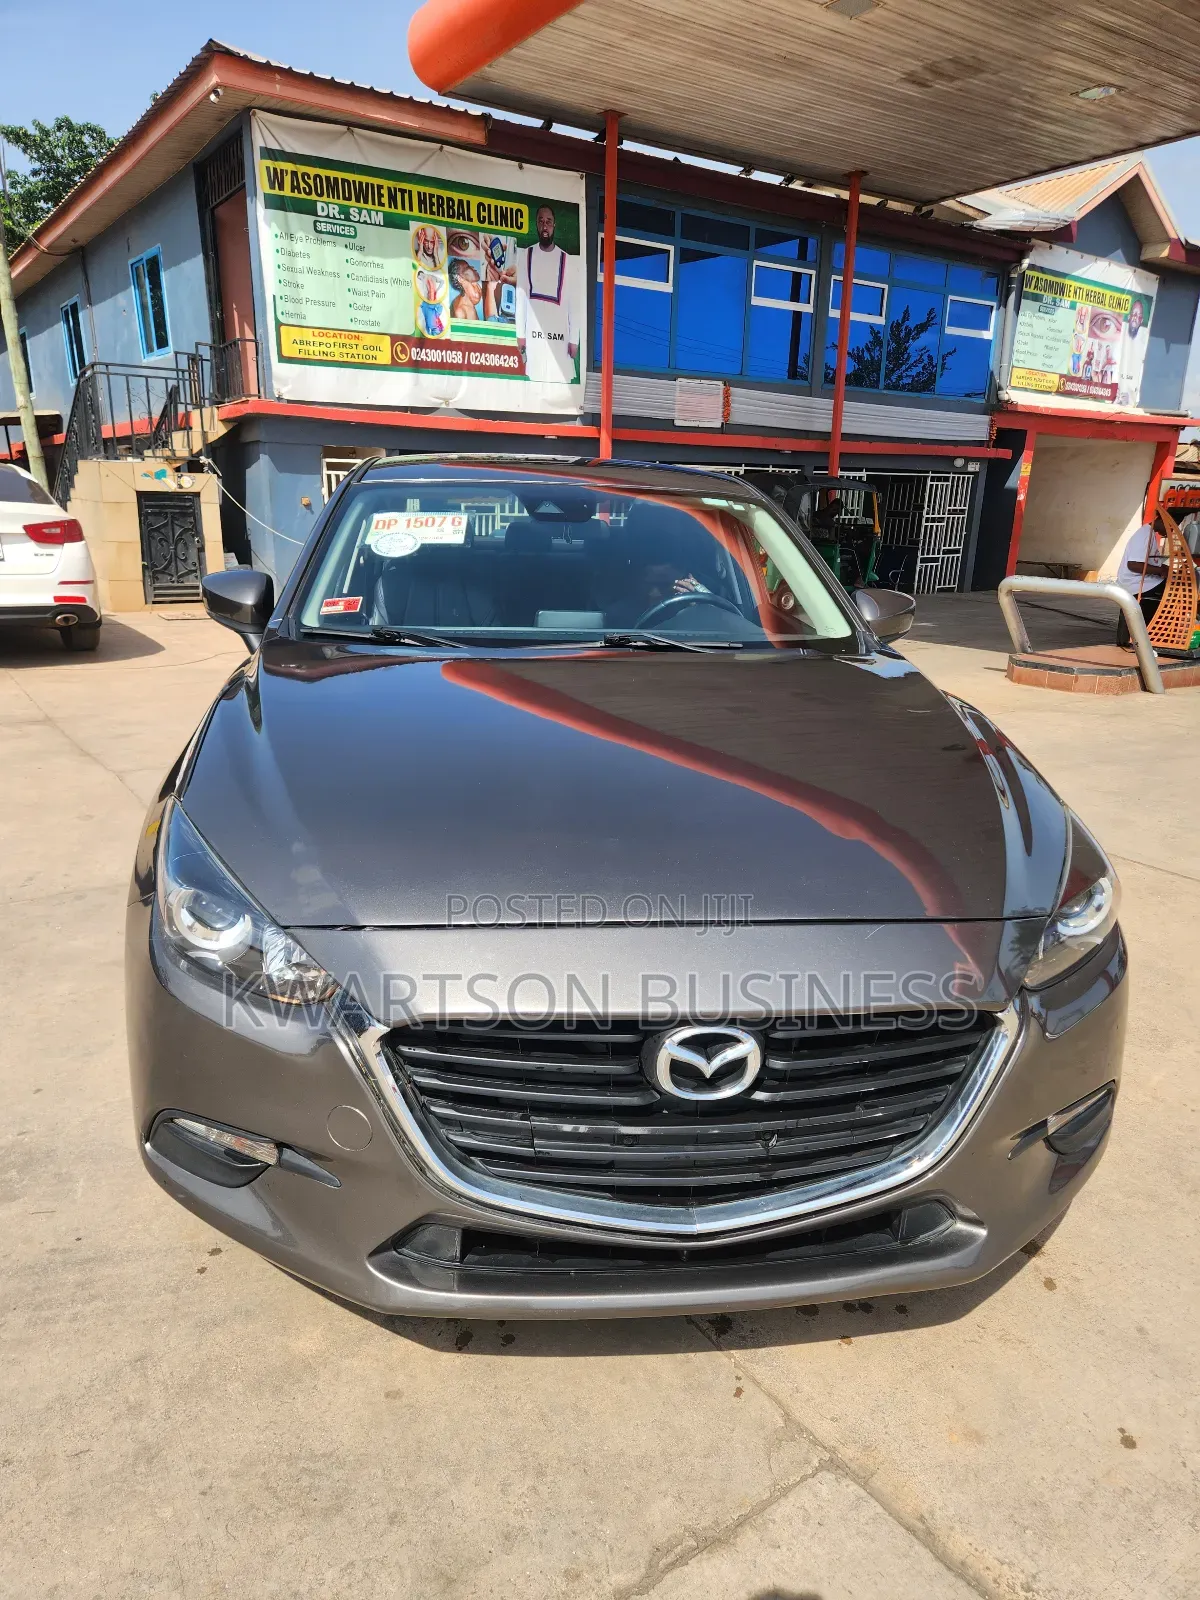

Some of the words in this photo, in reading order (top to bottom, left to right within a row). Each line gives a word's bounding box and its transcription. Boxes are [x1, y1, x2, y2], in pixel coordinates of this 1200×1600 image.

[317, 201, 345, 219] DR.
[350, 207, 384, 225] SAM
[387, 186, 413, 212] NTI
[417, 191, 473, 222] HERBAL
[477, 202, 524, 230] CLINIC
[316, 222, 355, 236] SERVICES
[290, 233, 303, 244] Eye
[305, 236, 336, 247] Problems
[348, 242, 365, 252] Ulcer
[280, 248, 310, 259] Diabetes
[350, 258, 384, 269] Gonorrhea
[282, 264, 304, 274] Sexual
[306, 267, 340, 278] Weakness
[282, 279, 304, 289] Stroke
[351, 273, 388, 284] Candidiasis
[352, 288, 369, 297] Waist
[371, 290, 385, 298] Pain
[284, 295, 303, 304] Blood
[305, 297, 336, 307] Pressure
[1055, 298, 1070, 309] SAM
[1085, 289, 1107, 306] HERBAL
[1108, 295, 1129, 311] CLINIC
[353, 302, 372, 311] Goiter
[285, 310, 306, 320] Hernia
[354, 317, 380, 327] Prostate
[312, 331, 363, 341] LOCATION:
[532, 331, 545, 339] DR.
[547, 332, 564, 341] SAM
[292, 338, 331, 348] ABREPO
[333, 342, 359, 350] FIRST
[298, 349, 335, 357] FILLING
[339, 352, 377, 360] STATION
[411, 347, 463, 364] 0243001058
[470, 353, 519, 368] 0243064243
[374, 519, 398, 530] DP
[405, 516, 447, 529] 1507
[451, 516, 463, 527] G
